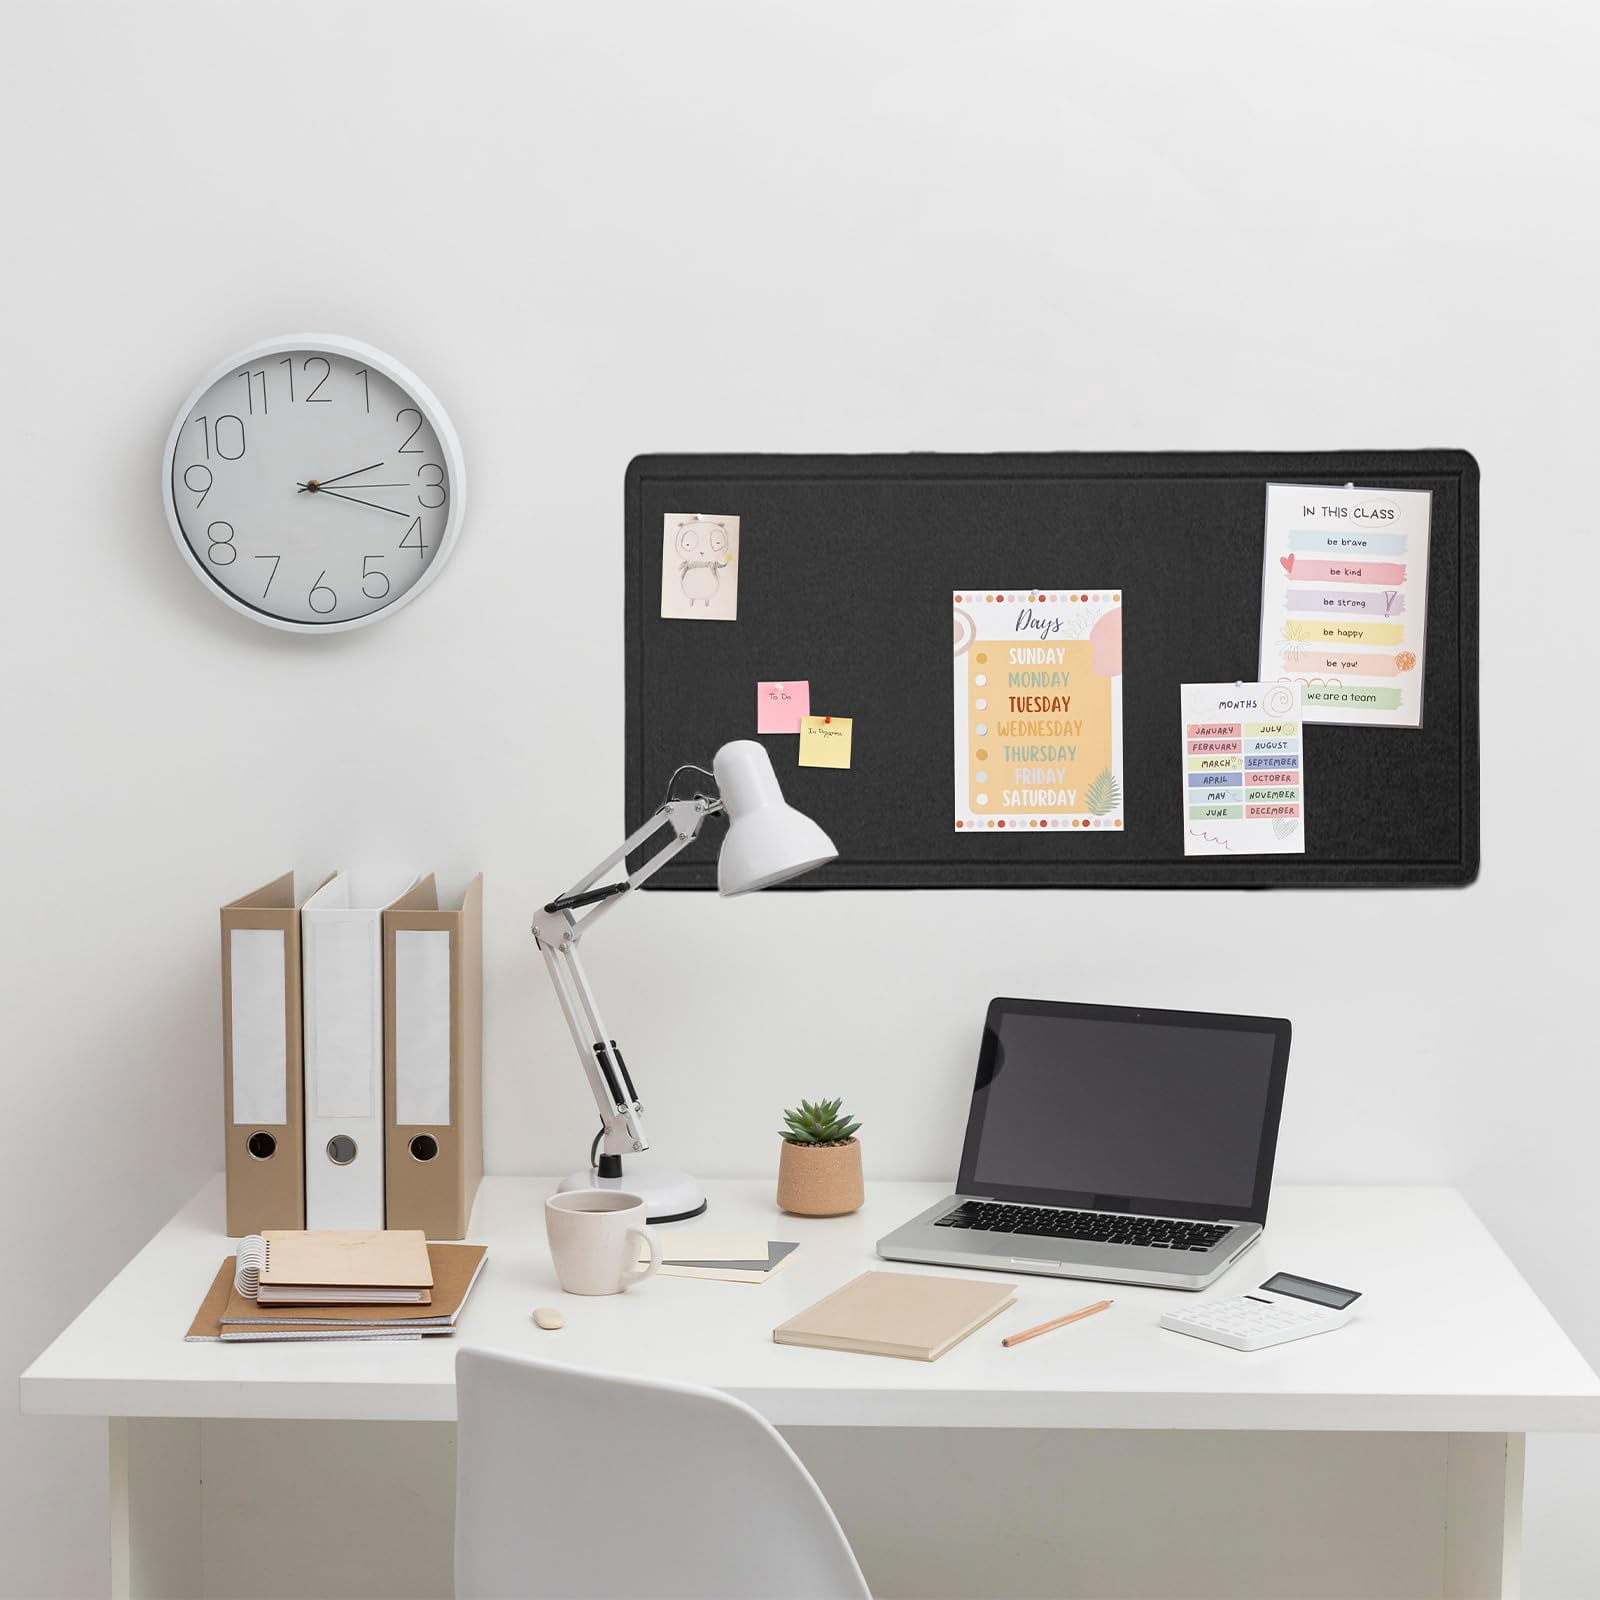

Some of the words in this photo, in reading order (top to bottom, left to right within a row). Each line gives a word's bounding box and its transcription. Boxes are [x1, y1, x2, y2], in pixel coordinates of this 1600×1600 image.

[279, 356, 333, 403] 12
[238, 370, 268, 415] 11
[355, 369, 370, 414] 1
[195, 414, 246, 461] 10
[396, 408, 425, 454] 2
[183, 464, 213, 509] 9
[417, 463, 447, 509] 3
[1303, 505, 1316, 518] IN
[1321, 505, 1349, 519] THIS
[1353, 507, 1396, 520] CLASS
[207, 521, 237, 566] 8
[398, 515, 429, 560] 4
[1327, 537, 1339, 547] be
[1341, 538, 1368, 548] brave
[254, 555, 281, 599] 7
[361, 555, 391, 600] 5
[1330, 568, 1341, 576] be
[1344, 567, 1363, 577] kind
[308, 570, 337, 614] 6
[1323, 597, 1335, 606] be
[1337, 598, 1367, 609] strong
[1015, 607, 1064, 641] Days
[1323, 628, 1335, 637] be
[1336, 628, 1364, 639] happy
[1008, 647, 1066, 665] SUNDAY
[1326, 659, 1338, 668] be
[1341, 660, 1359, 670] you!
[1008, 671, 1070, 688] MONDAY
[1008, 695, 1071, 714] TUESDAY
[1218, 700, 1258, 709] MONTHS
[1307, 691, 1322, 702] we
[1322, 692, 1340, 702] are
[1341, 693, 1349, 702] a
[1350, 692, 1377, 703] team
[997, 719, 1083, 737] WEDNESDAY
[1195, 726, 1234, 735] JANUARY
[1260, 725, 1282, 734] JULY
[1003, 744, 1077, 762] THURSDAY
[1192, 742, 1237, 752] FEBRUARY
[1254, 741, 1288, 750] AUGUST
[1201, 759, 1231, 769] MARCH
[1247, 757, 1297, 767] SEPTEMBER
[1014, 767, 1066, 785] FRIDAY
[1202, 775, 1228, 785] APRIL
[1252, 773, 1292, 783] OCTOBER
[1002, 789, 1077, 807] SATURDAY
[1207, 791, 1226, 801] MAY
[1249, 790, 1296, 800] NOVEMBER
[1205, 808, 1228, 817] JUNE
[1250, 806, 1295, 816] DECEMBER
